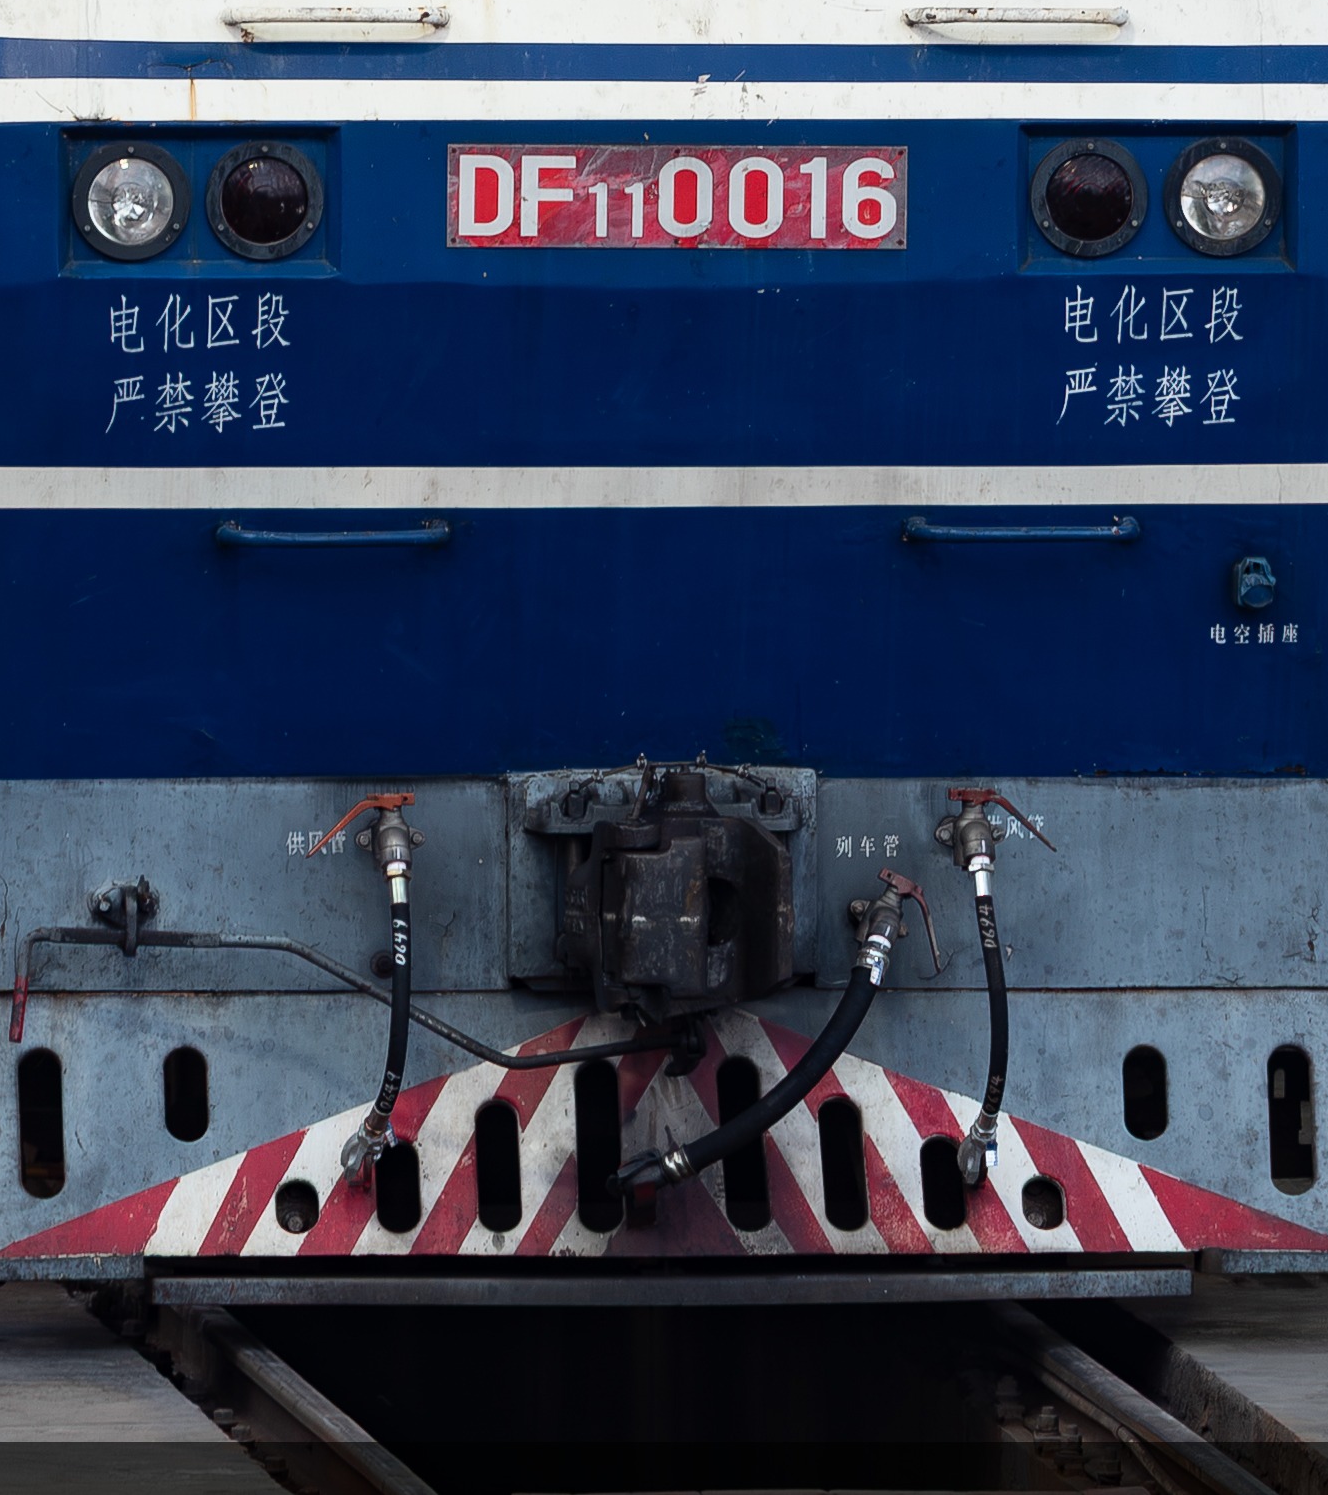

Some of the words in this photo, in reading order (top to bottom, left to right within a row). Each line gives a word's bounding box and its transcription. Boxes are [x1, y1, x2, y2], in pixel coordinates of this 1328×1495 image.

[458, 154, 897, 239] DF110016
[109, 292, 291, 353] 电化区段
[1063, 285, 1244, 344] 电化区段
[104, 371, 289, 434] 严禁攀登
[1056, 363, 1241, 427] 严禁攀登
[1209, 622, 1299, 645] 电空插座
[285, 830, 347, 856] 供风管
[835, 834, 899, 858] 列车管
[393, 918, 408, 966] 0649
